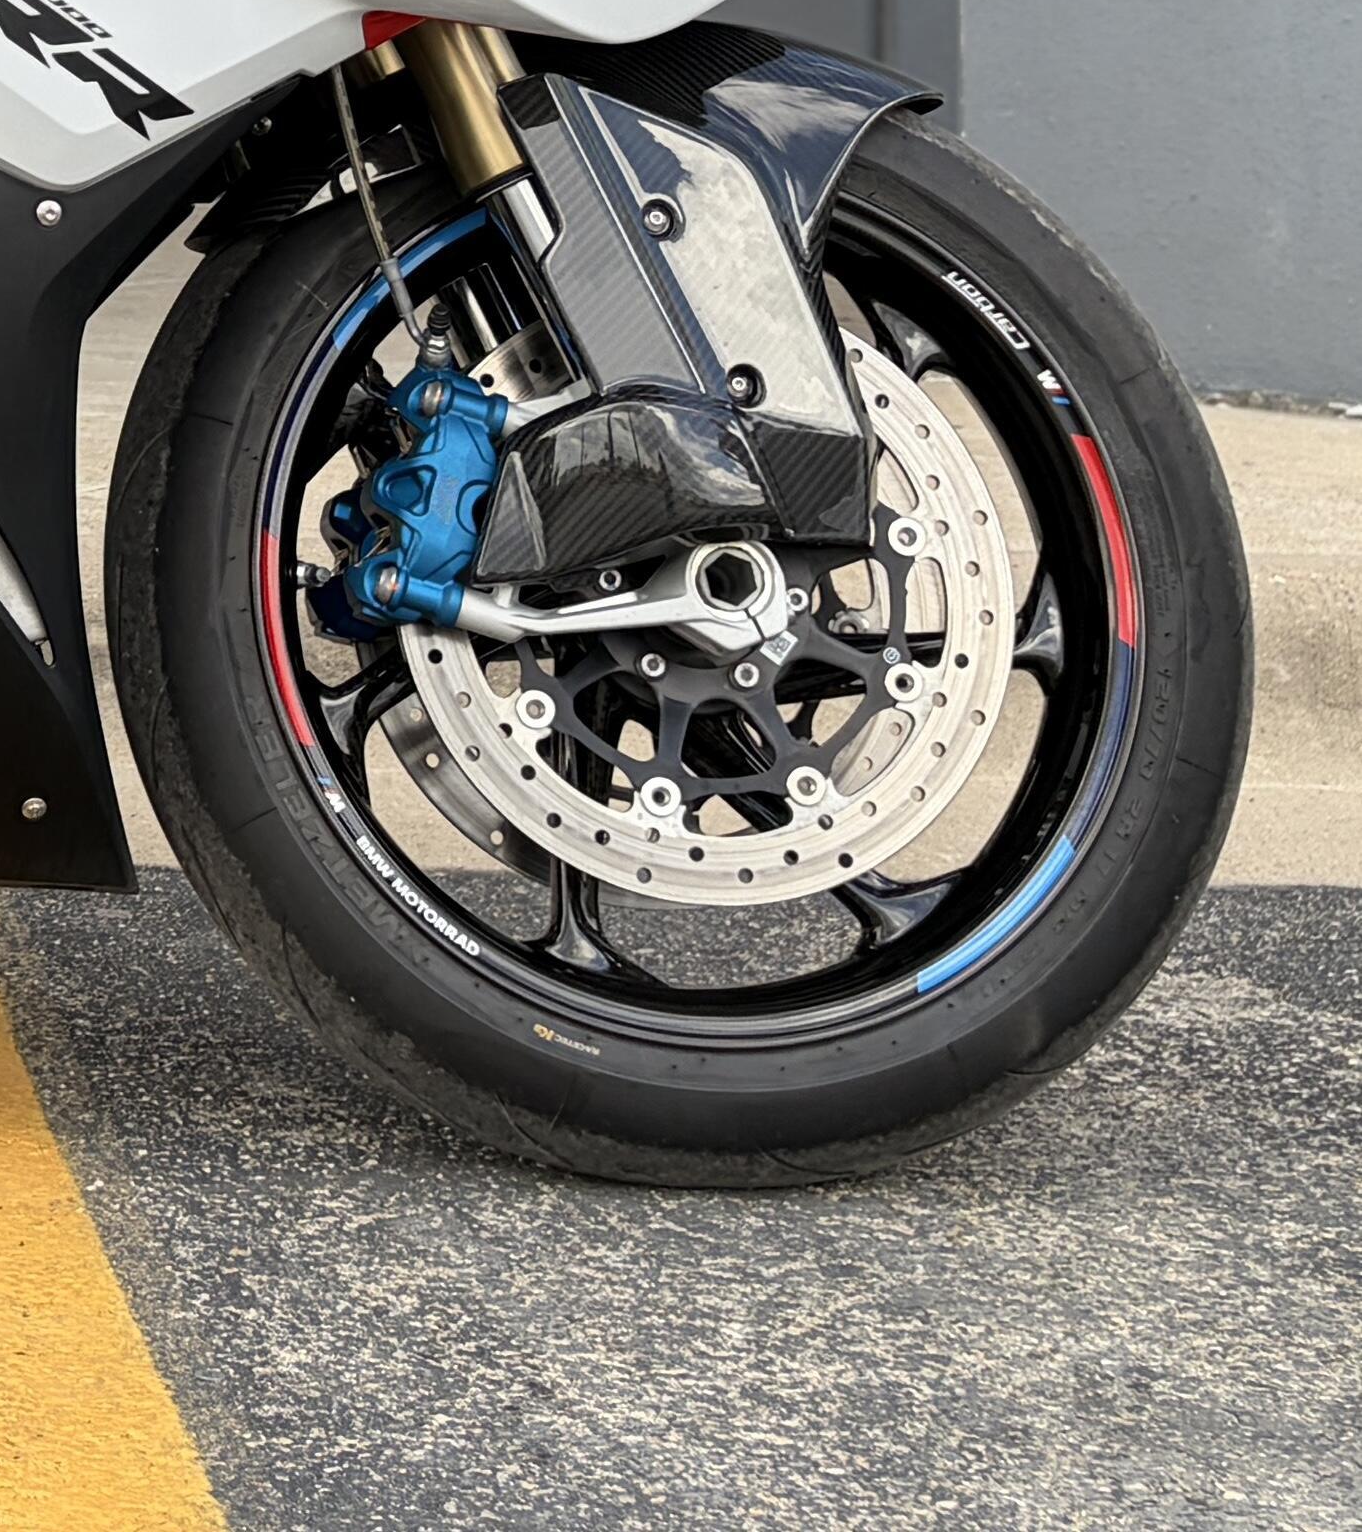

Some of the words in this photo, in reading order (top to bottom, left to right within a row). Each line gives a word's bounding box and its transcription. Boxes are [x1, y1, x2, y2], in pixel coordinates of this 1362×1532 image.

[242, 694, 400, 931] METZELER
[356, 835, 395, 878] BMW
[391, 878, 481, 956] MOTORRAD
